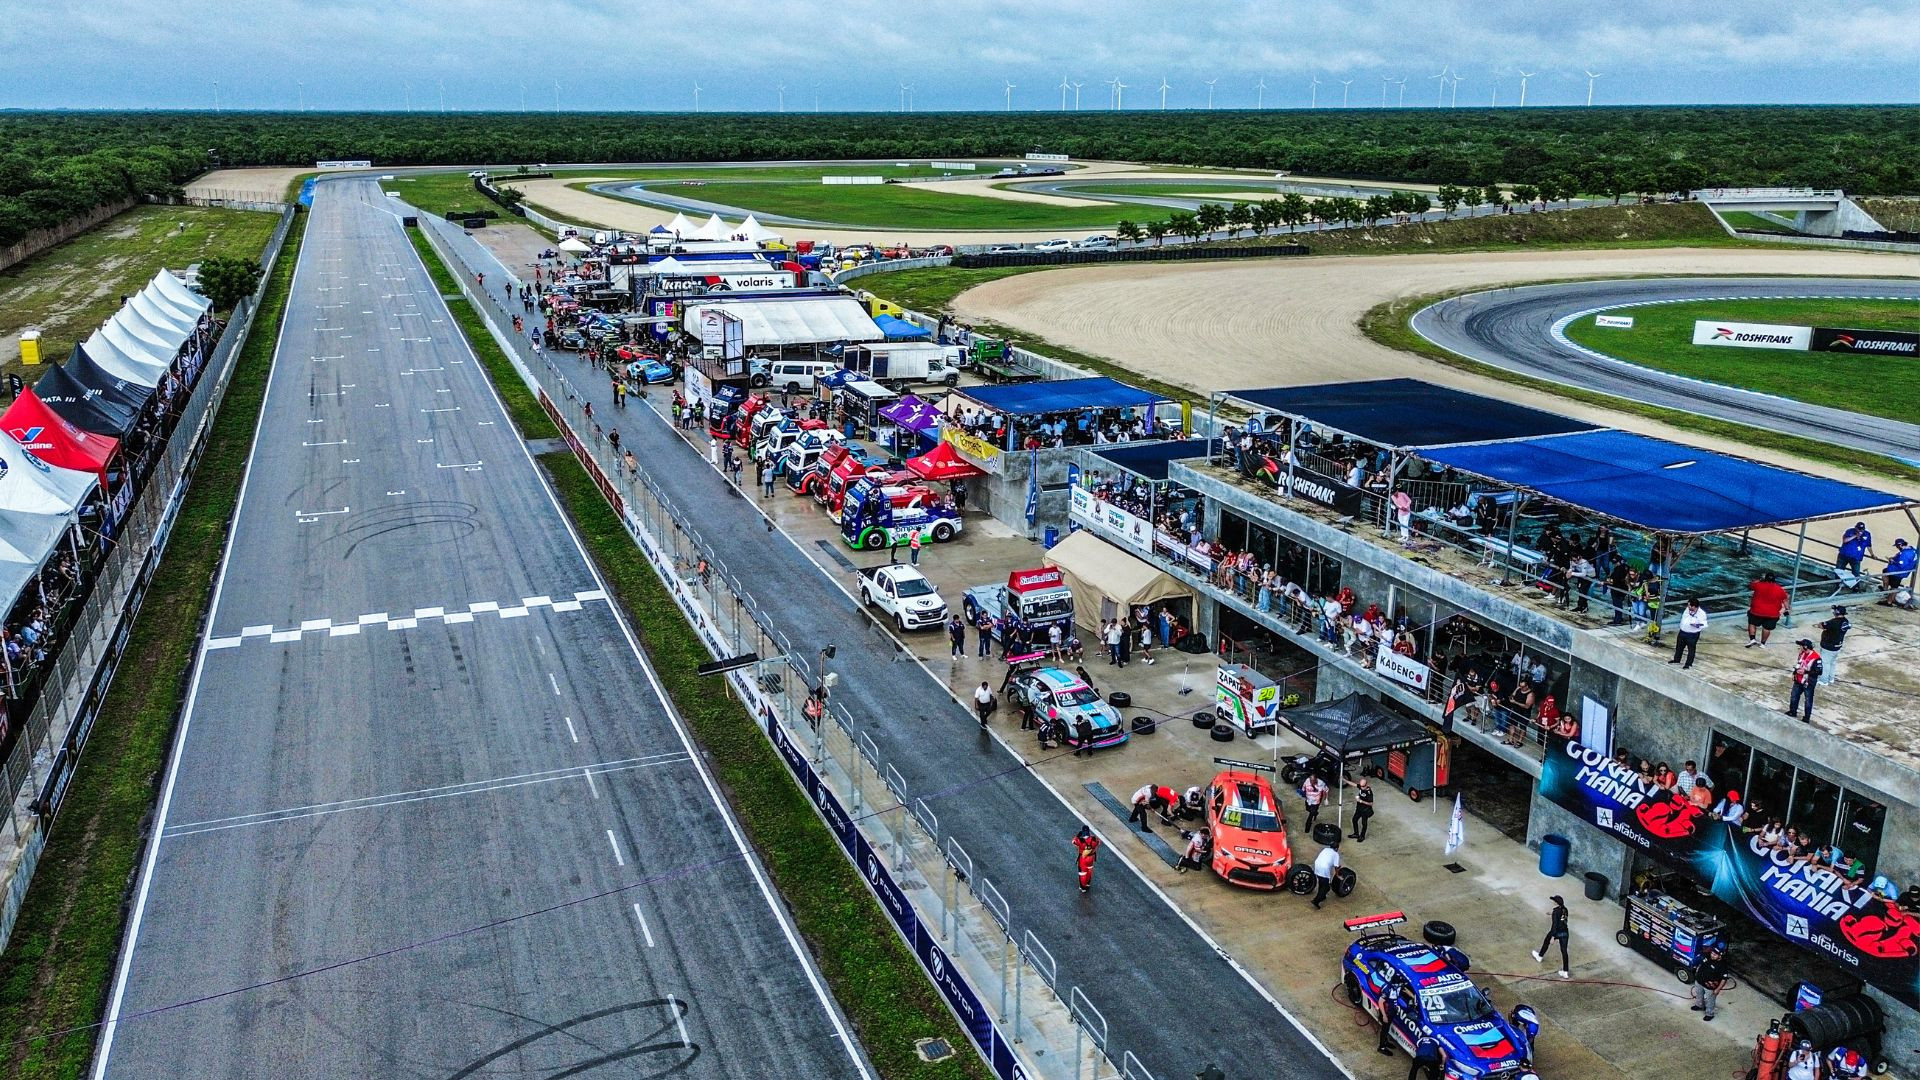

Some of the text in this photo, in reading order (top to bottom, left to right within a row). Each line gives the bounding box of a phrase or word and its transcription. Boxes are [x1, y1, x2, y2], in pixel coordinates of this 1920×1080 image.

[736, 277, 774, 287] volaris
[1734, 333, 1793, 344] ROSHFRANS
[1854, 340, 1916, 352] ROSHFRANS
[1278, 471, 1336, 504] ROSHFRANS
[896, 524, 927, 533] ompass
[1219, 670, 1240, 692] ZAPAT
[1258, 688, 1276, 702] 20
[1574, 766, 1645, 810] MANIA
[826, 802, 846, 833] FOTON
[1614, 822, 1650, 848] altabrisa
[880, 878, 903, 915] FOTON
[1760, 866, 1850, 921] MANIA
[1396, 949, 1430, 959] Chevron
[1810, 932, 1859, 966] altabrisa
[946, 974, 975, 1020] FOTON
[1426, 995, 1446, 1010] 29
[1453, 1022, 1494, 1034] Chevron
